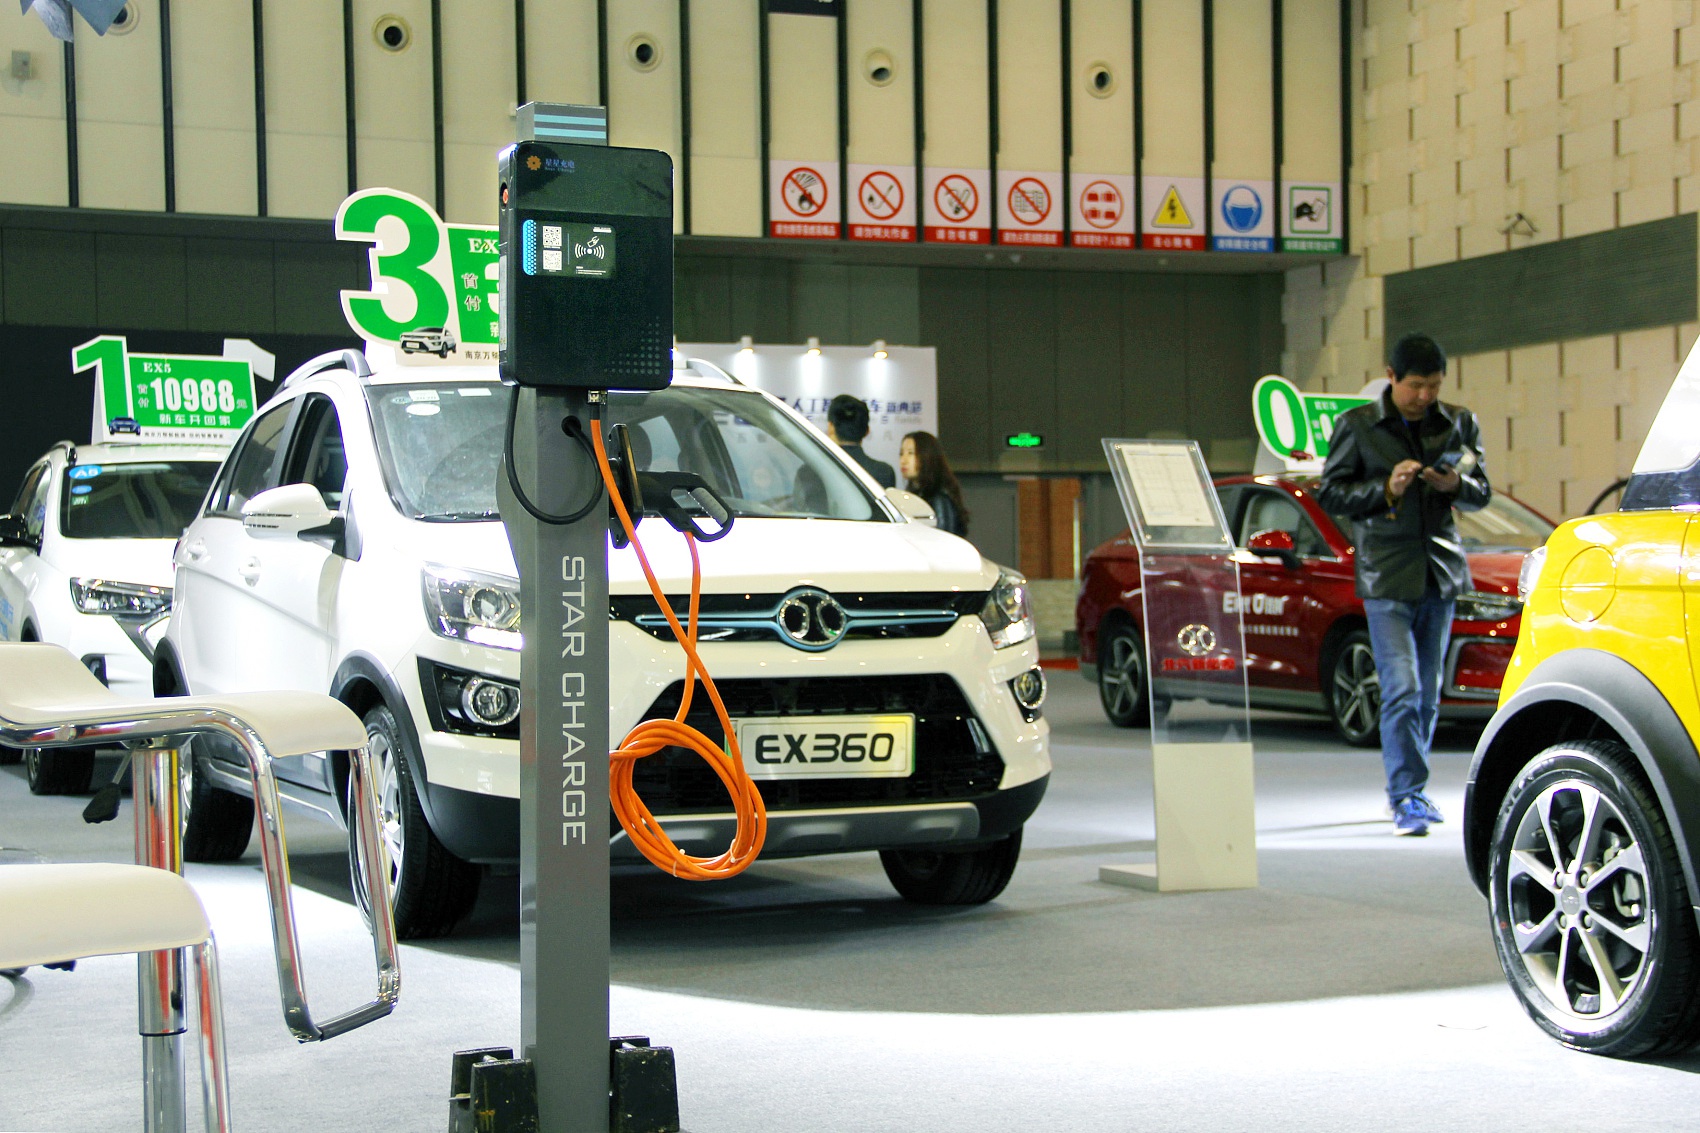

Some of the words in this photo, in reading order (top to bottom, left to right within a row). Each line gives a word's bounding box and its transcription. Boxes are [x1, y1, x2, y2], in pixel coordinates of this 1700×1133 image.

[461, 272, 482, 312] 首付
[150, 377, 236, 413] 10988
[159, 413, 232, 426] 新车开回家
[561, 555, 586, 659] STAR
[561, 671, 587, 846] CHARGE
[754, 732, 895, 764] EX360
